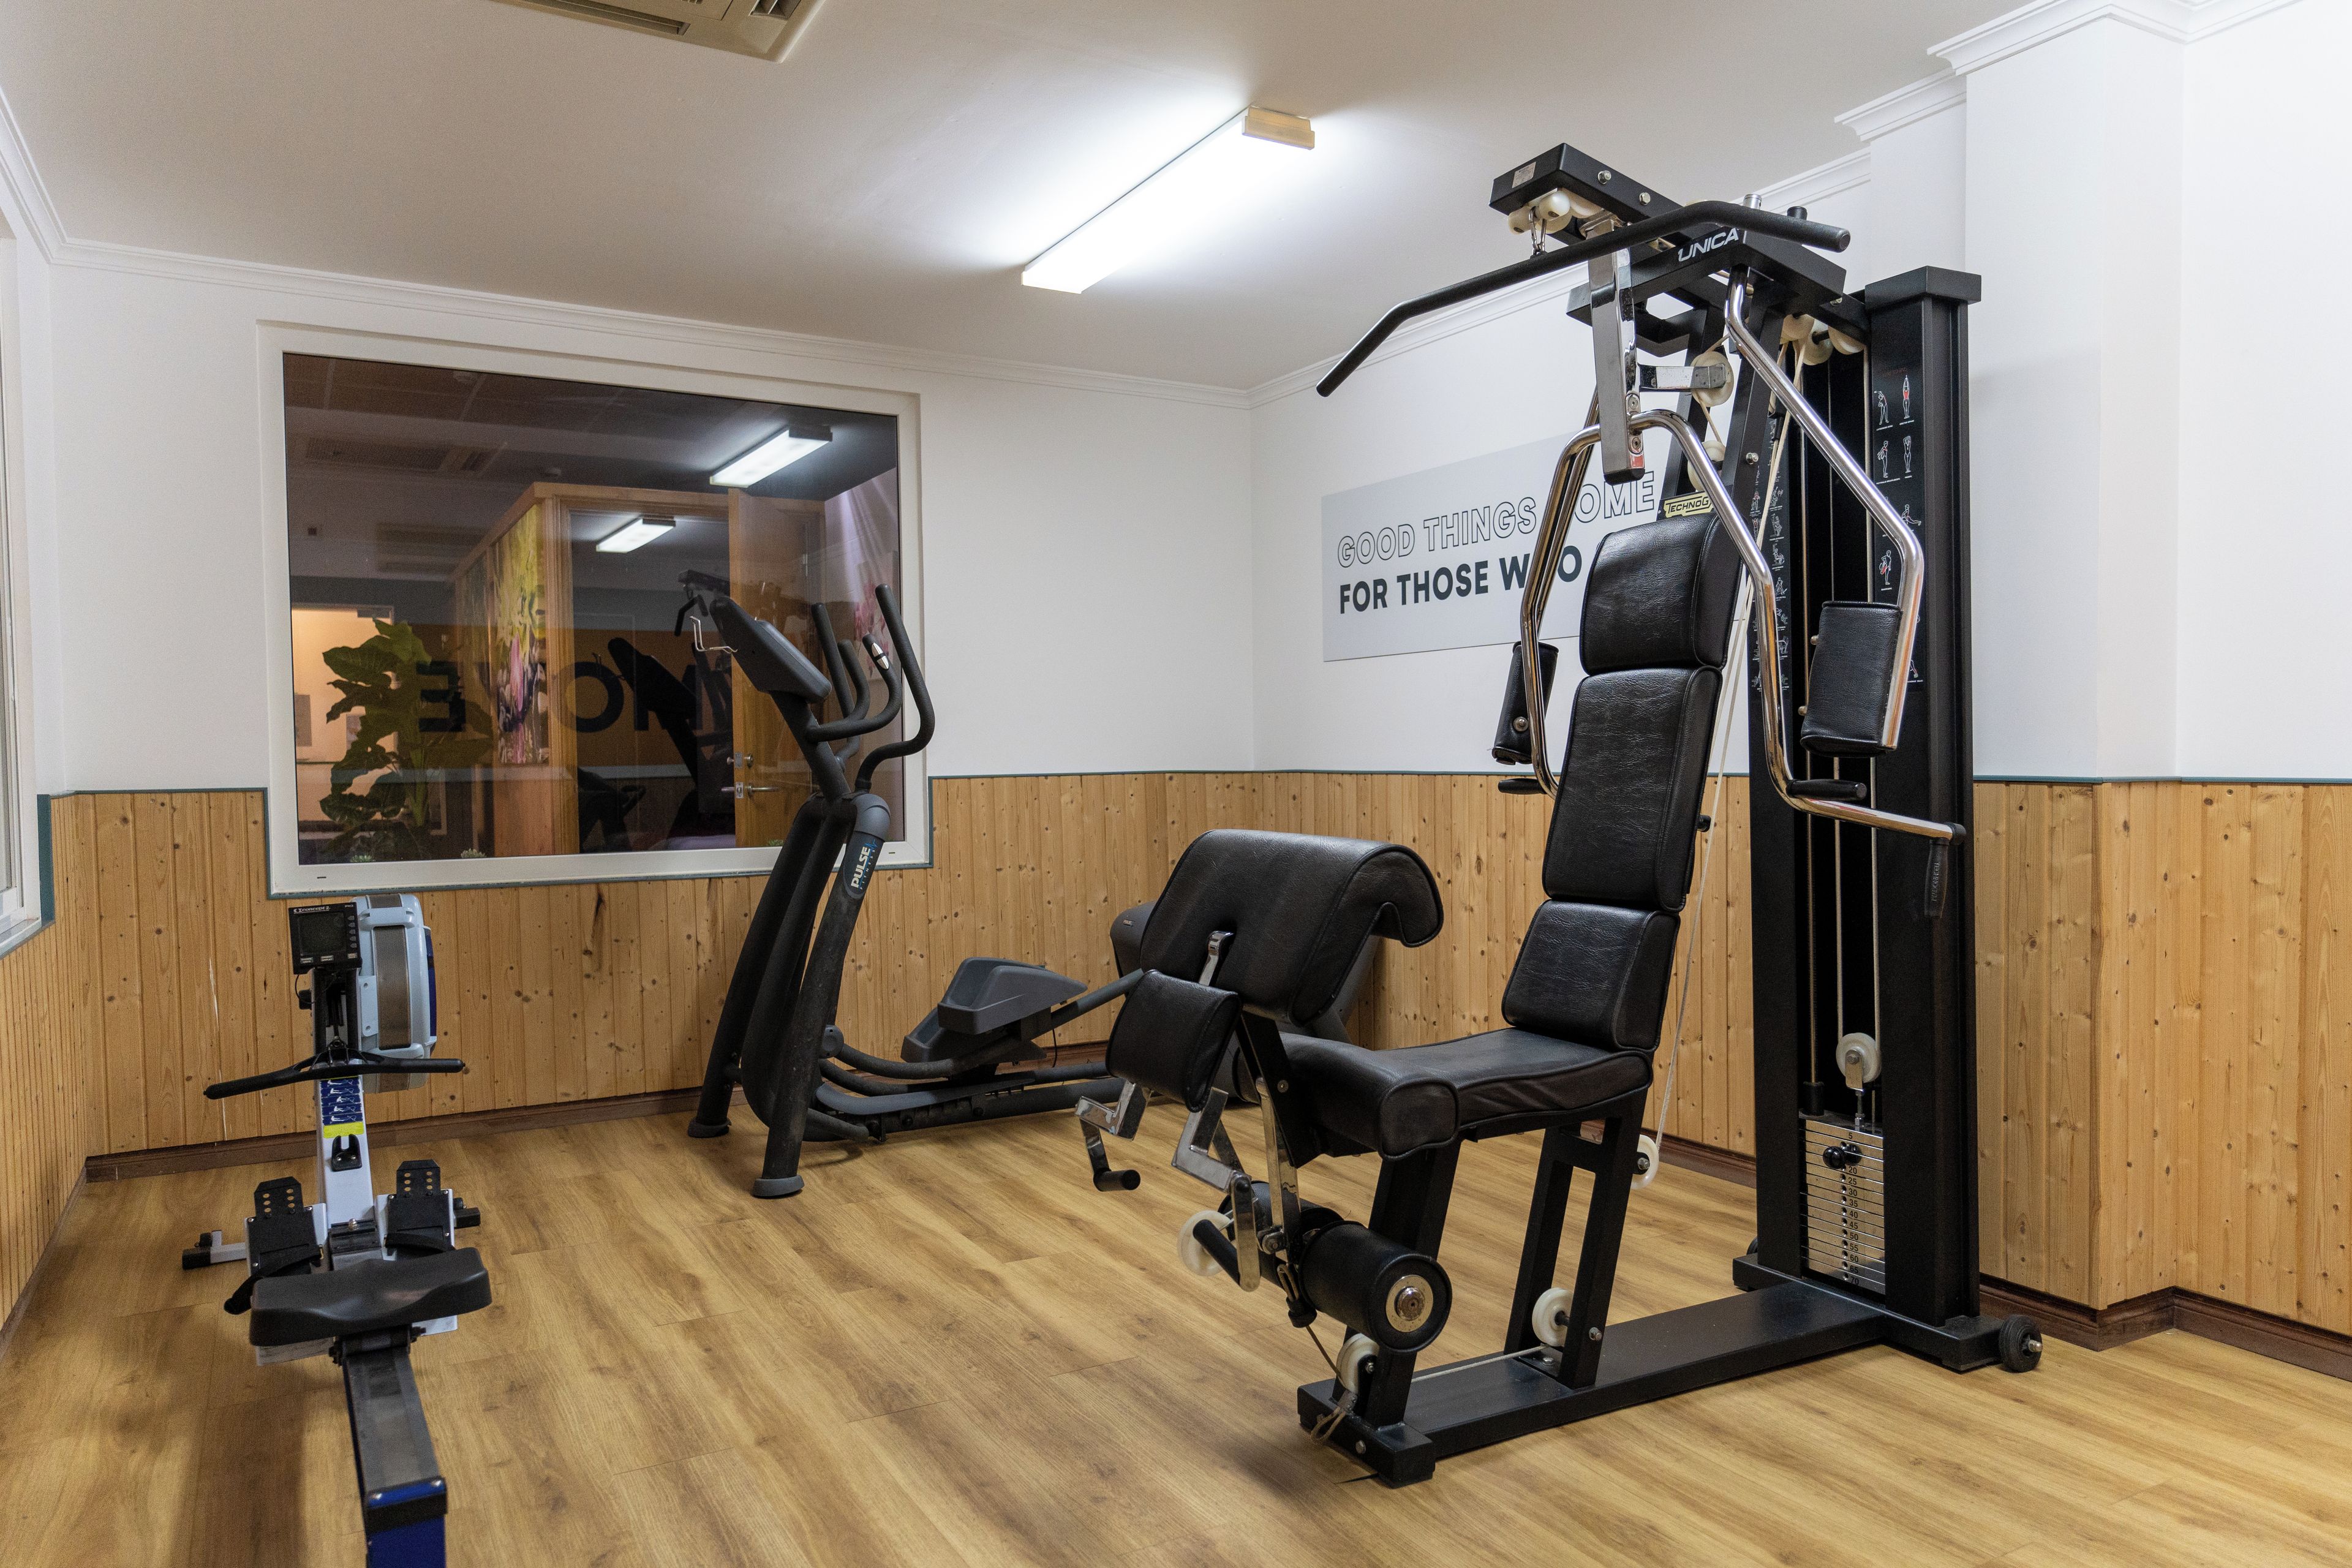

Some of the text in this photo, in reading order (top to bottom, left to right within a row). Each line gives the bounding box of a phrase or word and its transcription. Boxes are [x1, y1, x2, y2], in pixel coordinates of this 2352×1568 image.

[1678, 228, 1739, 262] UNICA
[1665, 496, 1711, 513] TECHNOG
[1338, 471, 1654, 568] GOOD THINGS OME
[1340, 546, 1582, 614] FOR THOSE WO
[850, 846, 871, 888] PULSE
[1849, 1199, 1858, 1207] 35
[1850, 1232, 1858, 1241] 50
[1850, 1276, 1860, 1285] 70
